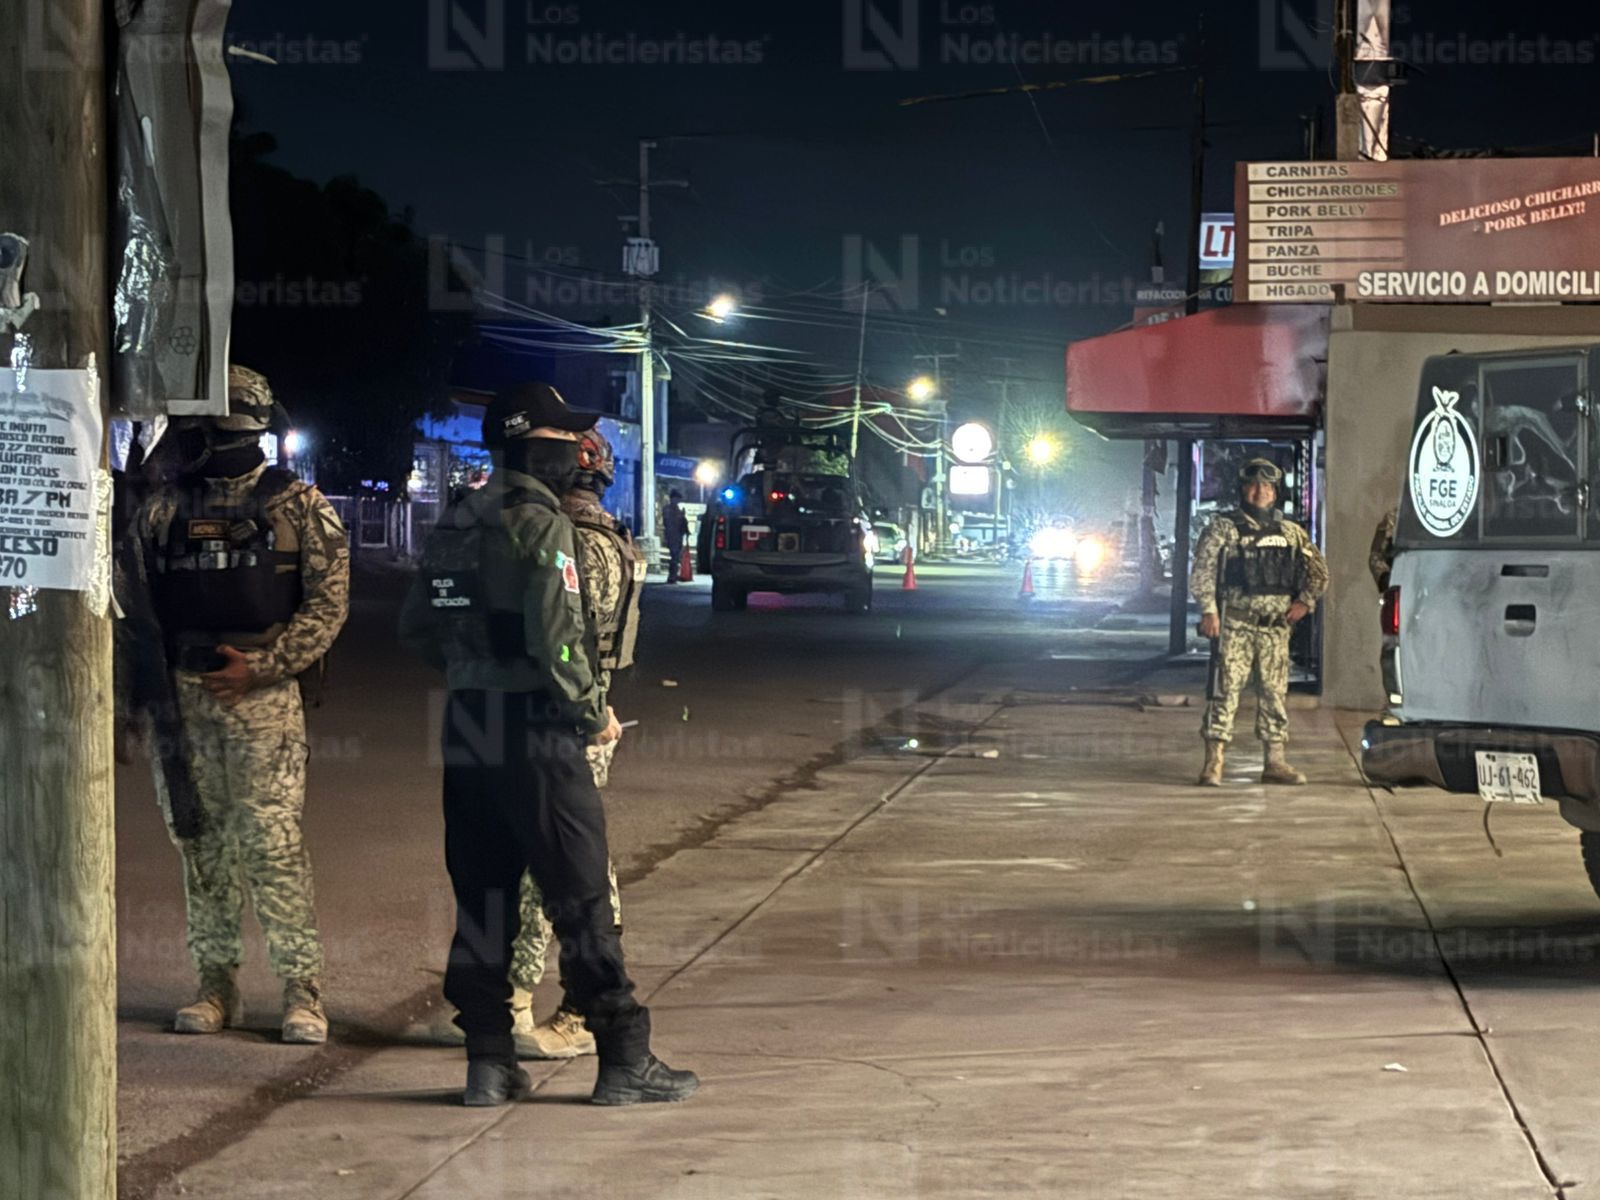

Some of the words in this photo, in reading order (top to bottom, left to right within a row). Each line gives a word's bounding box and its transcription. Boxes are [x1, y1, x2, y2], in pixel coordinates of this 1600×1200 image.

[1266, 165, 1349, 178] CARNITAS
[1266, 183, 1398, 198] CHICHARRONES
[1266, 206, 1312, 218] PORK
[1317, 204, 1368, 217] BELLY
[1439, 198, 1522, 227] DELICIOSO
[1484, 213, 1527, 234] PORK
[1530, 200, 1586, 224] BELLY!!
[1266, 225, 1314, 238] TRIPA
[1266, 245, 1320, 257] PANZA
[1266, 265, 1322, 277] BUCHE
[1358, 271, 1466, 296] SERVICIO
[1472, 271, 1489, 295] A
[1266, 285, 1330, 297] HIGADO
[21, 466, 60, 478] LEXUS
[1429, 479, 1457, 499] FGE
[22, 490, 43, 505] 7
[46, 490, 71, 508] PM
[1429, 498, 1457, 508] SINALOA
